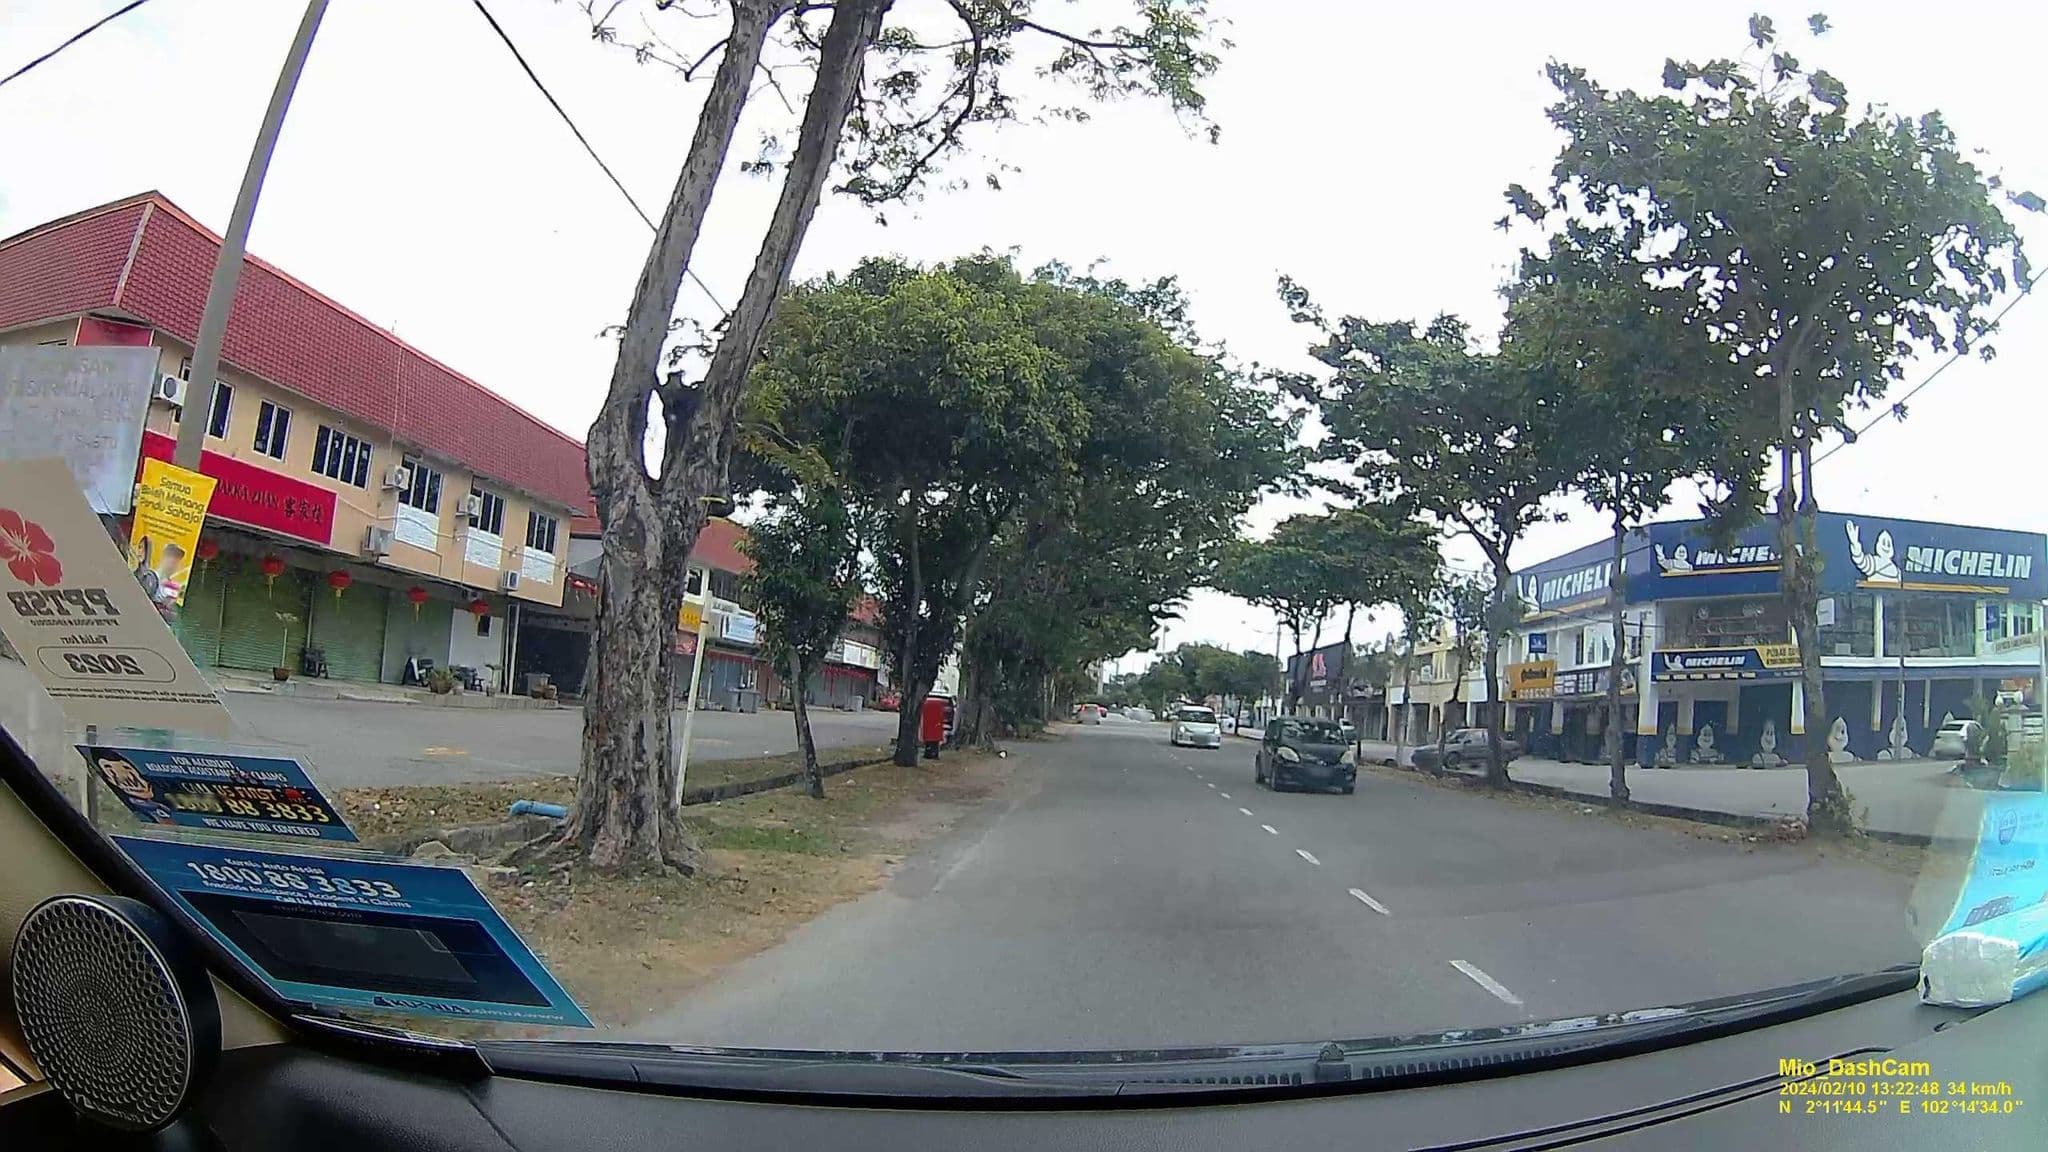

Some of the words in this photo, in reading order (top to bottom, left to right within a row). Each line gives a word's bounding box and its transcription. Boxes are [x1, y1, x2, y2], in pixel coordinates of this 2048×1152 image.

[160, 477, 191, 495] Semua
[1904, 546, 2032, 579] MICHELIN
[1685, 656, 1745, 667] MICHELIN
[181, 782, 211, 794] CALL
[215, 784, 235, 798] US
[237, 786, 276, 800] FIRST
[226, 799, 260, 816] 88
[261, 801, 330, 823] 3833
[202, 818, 220, 828] WE
[221, 819, 249, 831] HAVE
[249, 821, 271, 832] YOU
[272, 823, 320, 837] COVERED
[187, 861, 262, 886] 1800
[263, 870, 309, 890] 88
[309, 875, 401, 899] 3833
